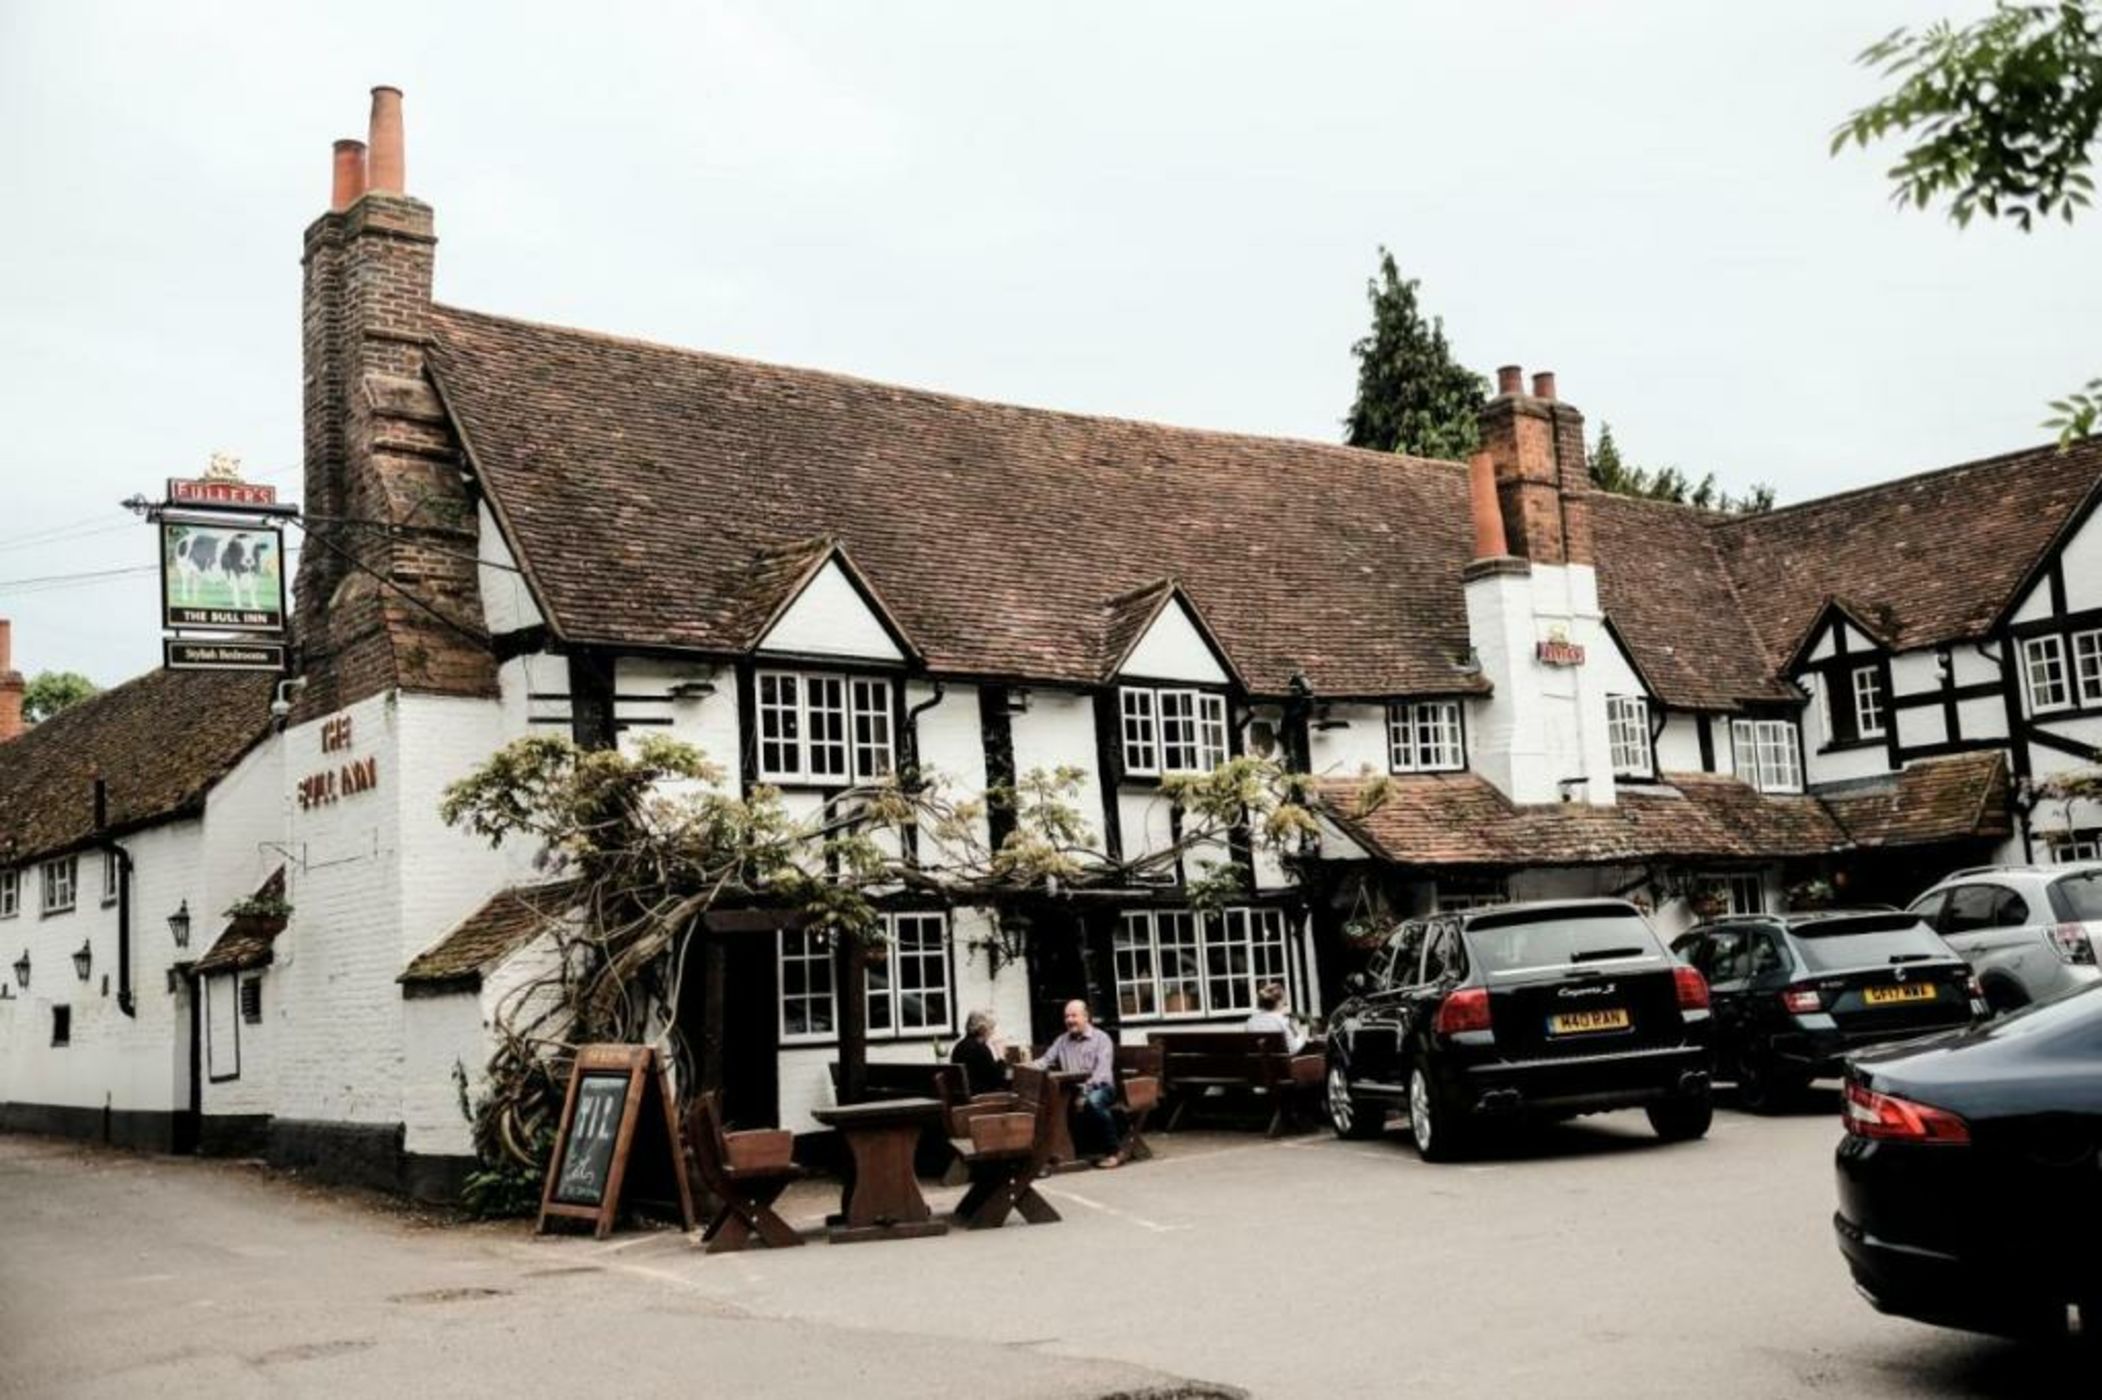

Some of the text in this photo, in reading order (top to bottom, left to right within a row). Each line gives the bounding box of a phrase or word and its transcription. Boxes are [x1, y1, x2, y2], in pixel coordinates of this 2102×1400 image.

[177, 481, 271, 504] FULLER'S
[184, 610, 268, 624] THE BULL INN
[321, 715, 353, 754] THE
